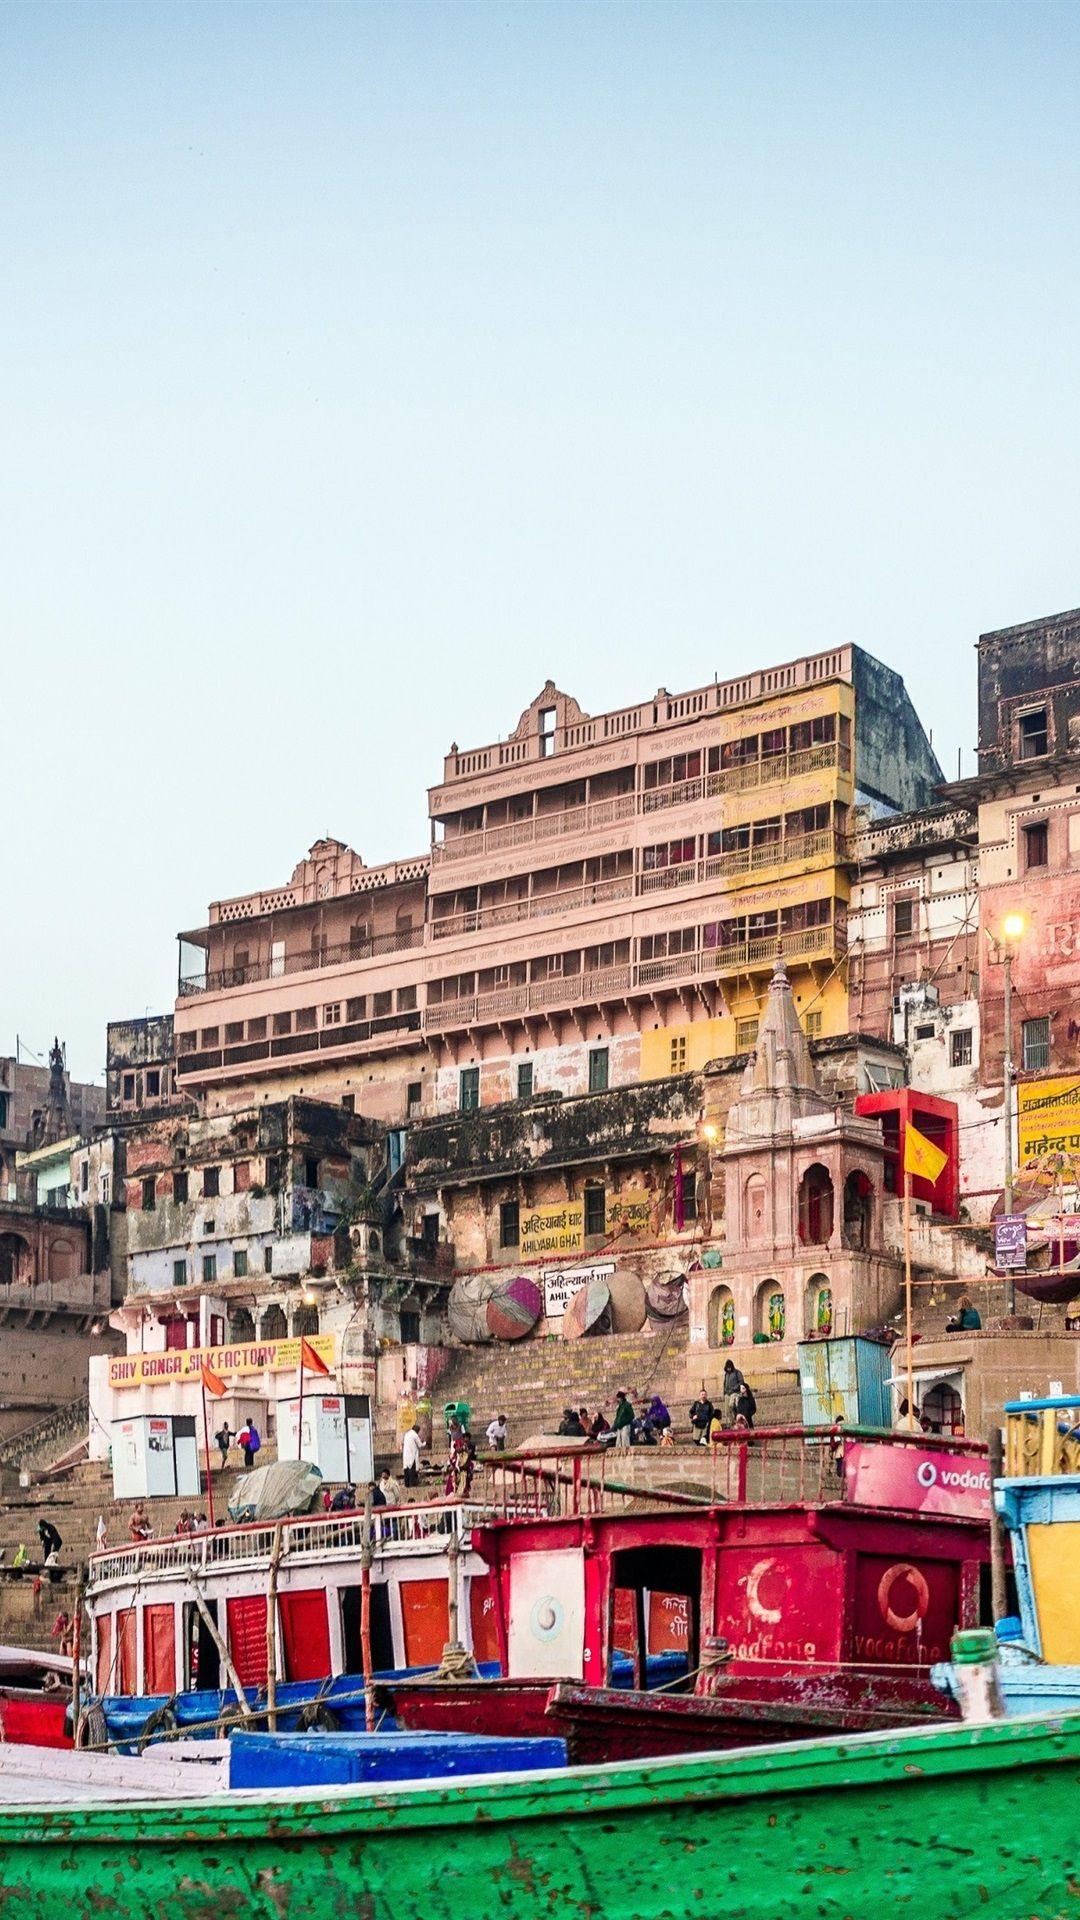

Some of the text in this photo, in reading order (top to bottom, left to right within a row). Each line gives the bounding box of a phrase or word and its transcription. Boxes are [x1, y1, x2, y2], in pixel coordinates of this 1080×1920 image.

[521, 1233, 581, 1253] AHILYABAI GHAT
[111, 1362, 137, 1381] SHIV
[141, 1356, 182, 1377] GANGA
[217, 1346, 276, 1369] FACTORY
